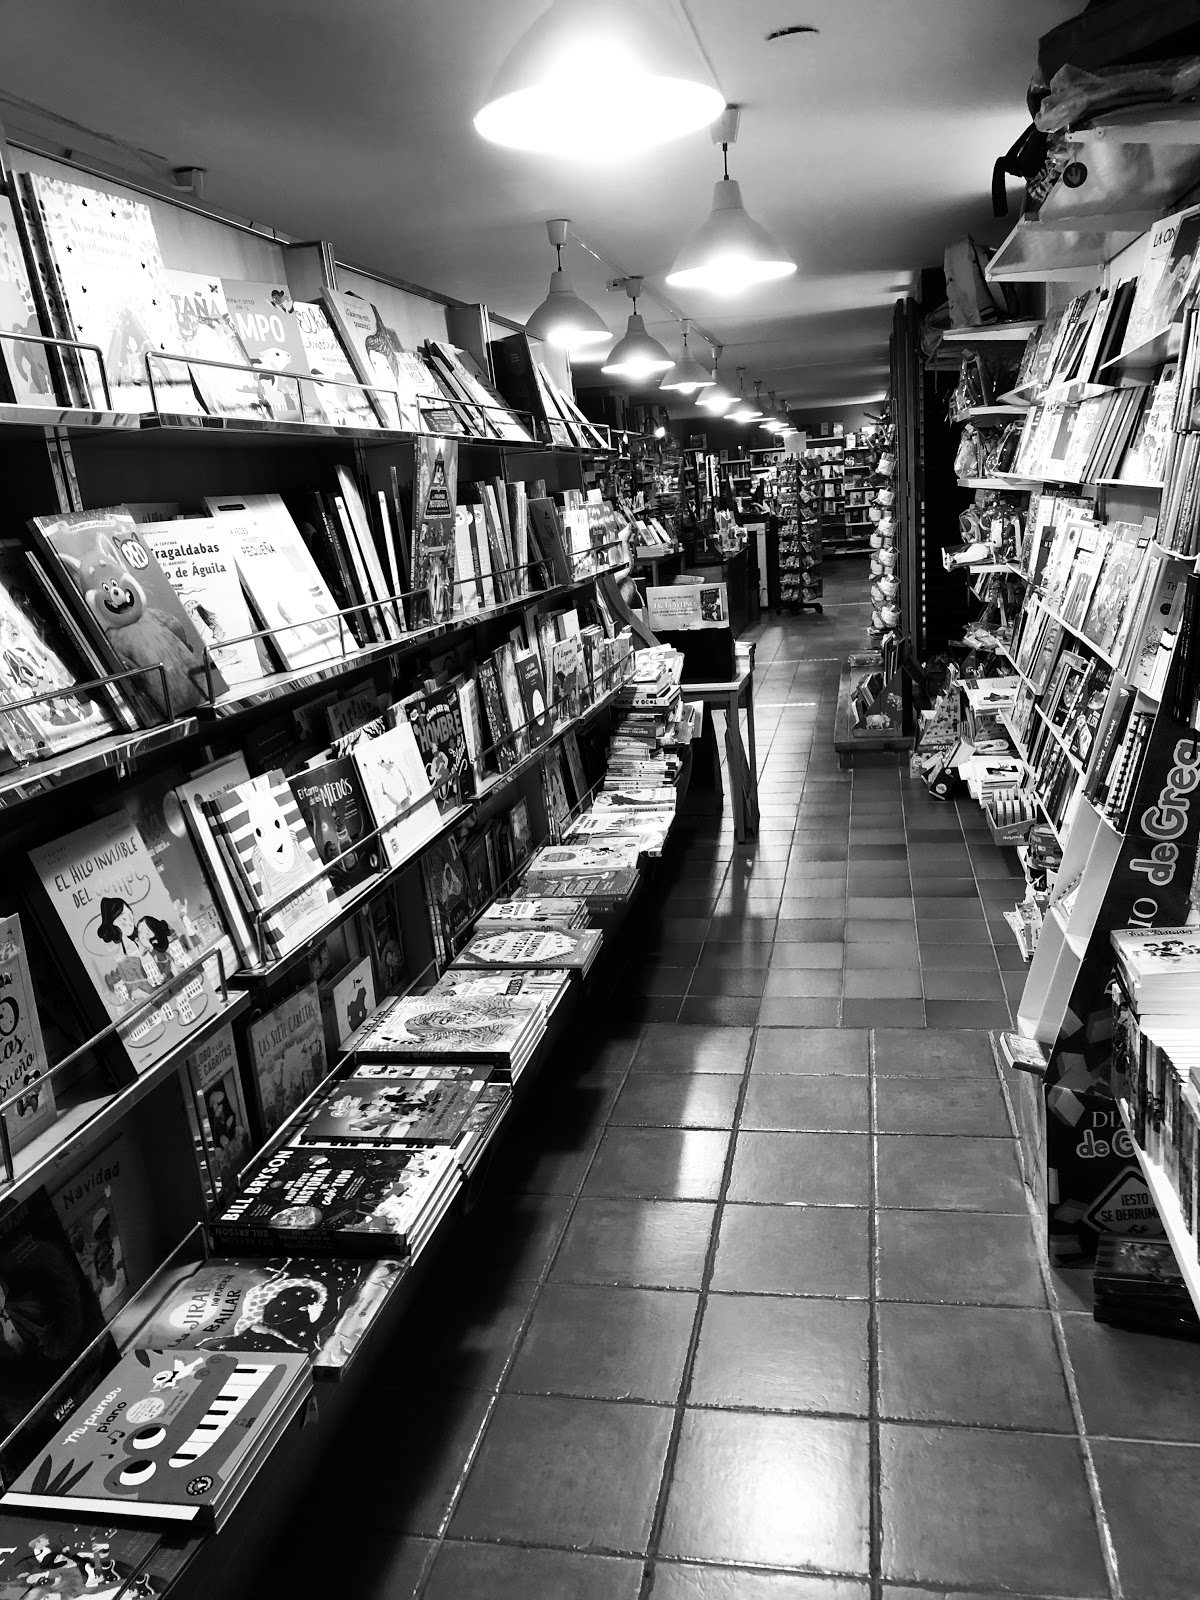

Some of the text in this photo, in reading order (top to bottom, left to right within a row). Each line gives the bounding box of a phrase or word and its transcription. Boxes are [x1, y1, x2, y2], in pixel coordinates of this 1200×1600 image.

[235, 313, 286, 343] MPO
[151, 543, 220, 560] ragaldabas
[176, 566, 189, 579] de
[192, 562, 227, 578] Águila
[419, 709, 463, 753] HOMBRE
[55, 873, 71, 893] EL
[70, 858, 94, 885] HILO
[94, 836, 139, 873] INVISIBLE
[1129, 842, 1179, 887] de
[73, 886, 94, 909] DEL
[198, 1046, 212, 1066] OBO
[203, 1043, 232, 1077] CABRITAS
[258, 1034, 271, 1059] LAS
[1076, 1128, 1111, 1159] de
[62, 1161, 121, 1210] Navidad
[220, 1150, 295, 1221] BILL BRYSON
[291, 1169, 333, 1206] HISTORIA
[330, 1169, 355, 1187] TODO
[1101, 1206, 1160, 1222] SE DERRUM
[201, 1289, 243, 1333] BAILAR
[62, 1386, 123, 1446] mi primer
[96, 1401, 128, 1434] piano
